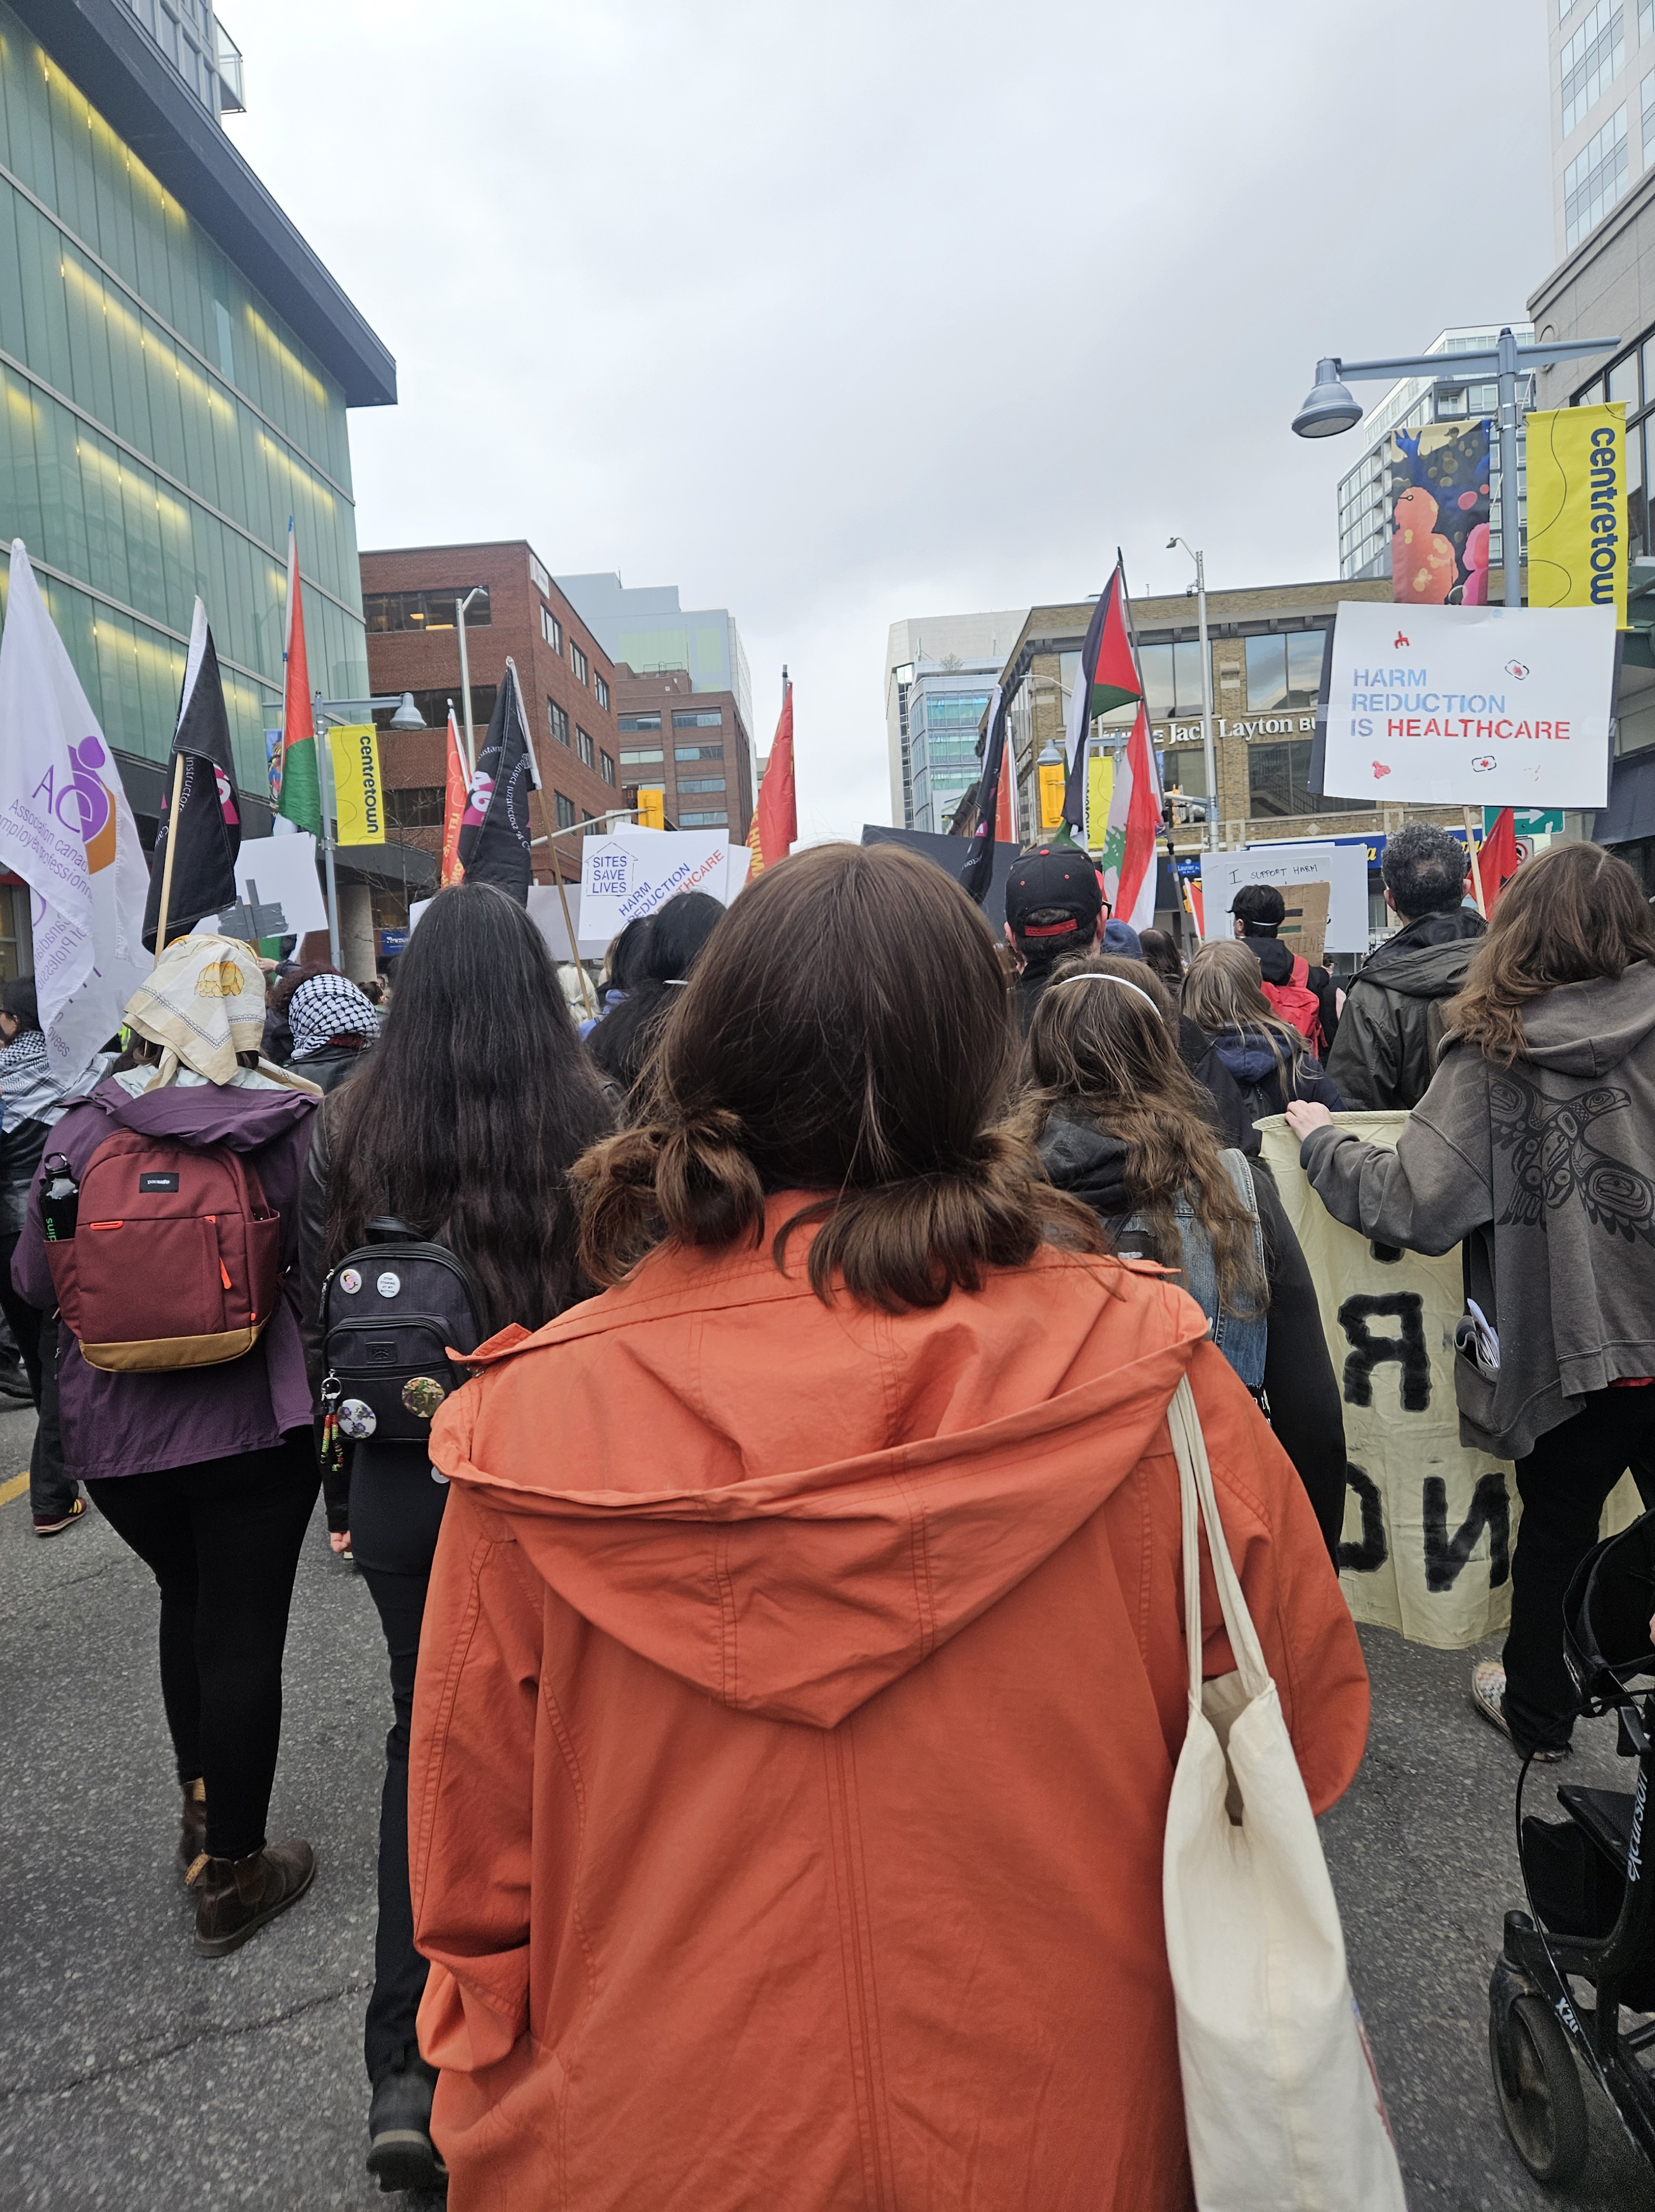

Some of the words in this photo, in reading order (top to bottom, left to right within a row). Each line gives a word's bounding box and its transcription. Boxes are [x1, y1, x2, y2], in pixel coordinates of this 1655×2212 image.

[1590, 427, 1618, 604] centretow
[1353, 669, 1427, 687] HARM
[1351, 693, 1505, 713] REDUCTION
[1219, 718, 1293, 741] Layton
[1350, 718, 1373, 737] IS
[1387, 718, 1570, 740] HEALTHCARE
[360, 736, 379, 833] centretown
[593, 856, 627, 868] SITES
[594, 869, 625, 880] SAVE
[1229, 869, 1242, 884] I
[1251, 868, 1287, 879] SUPPORT
[1293, 864, 1318, 875] HARM
[592, 882, 626, 893] LIVES
[618, 882, 651, 916] HARM
